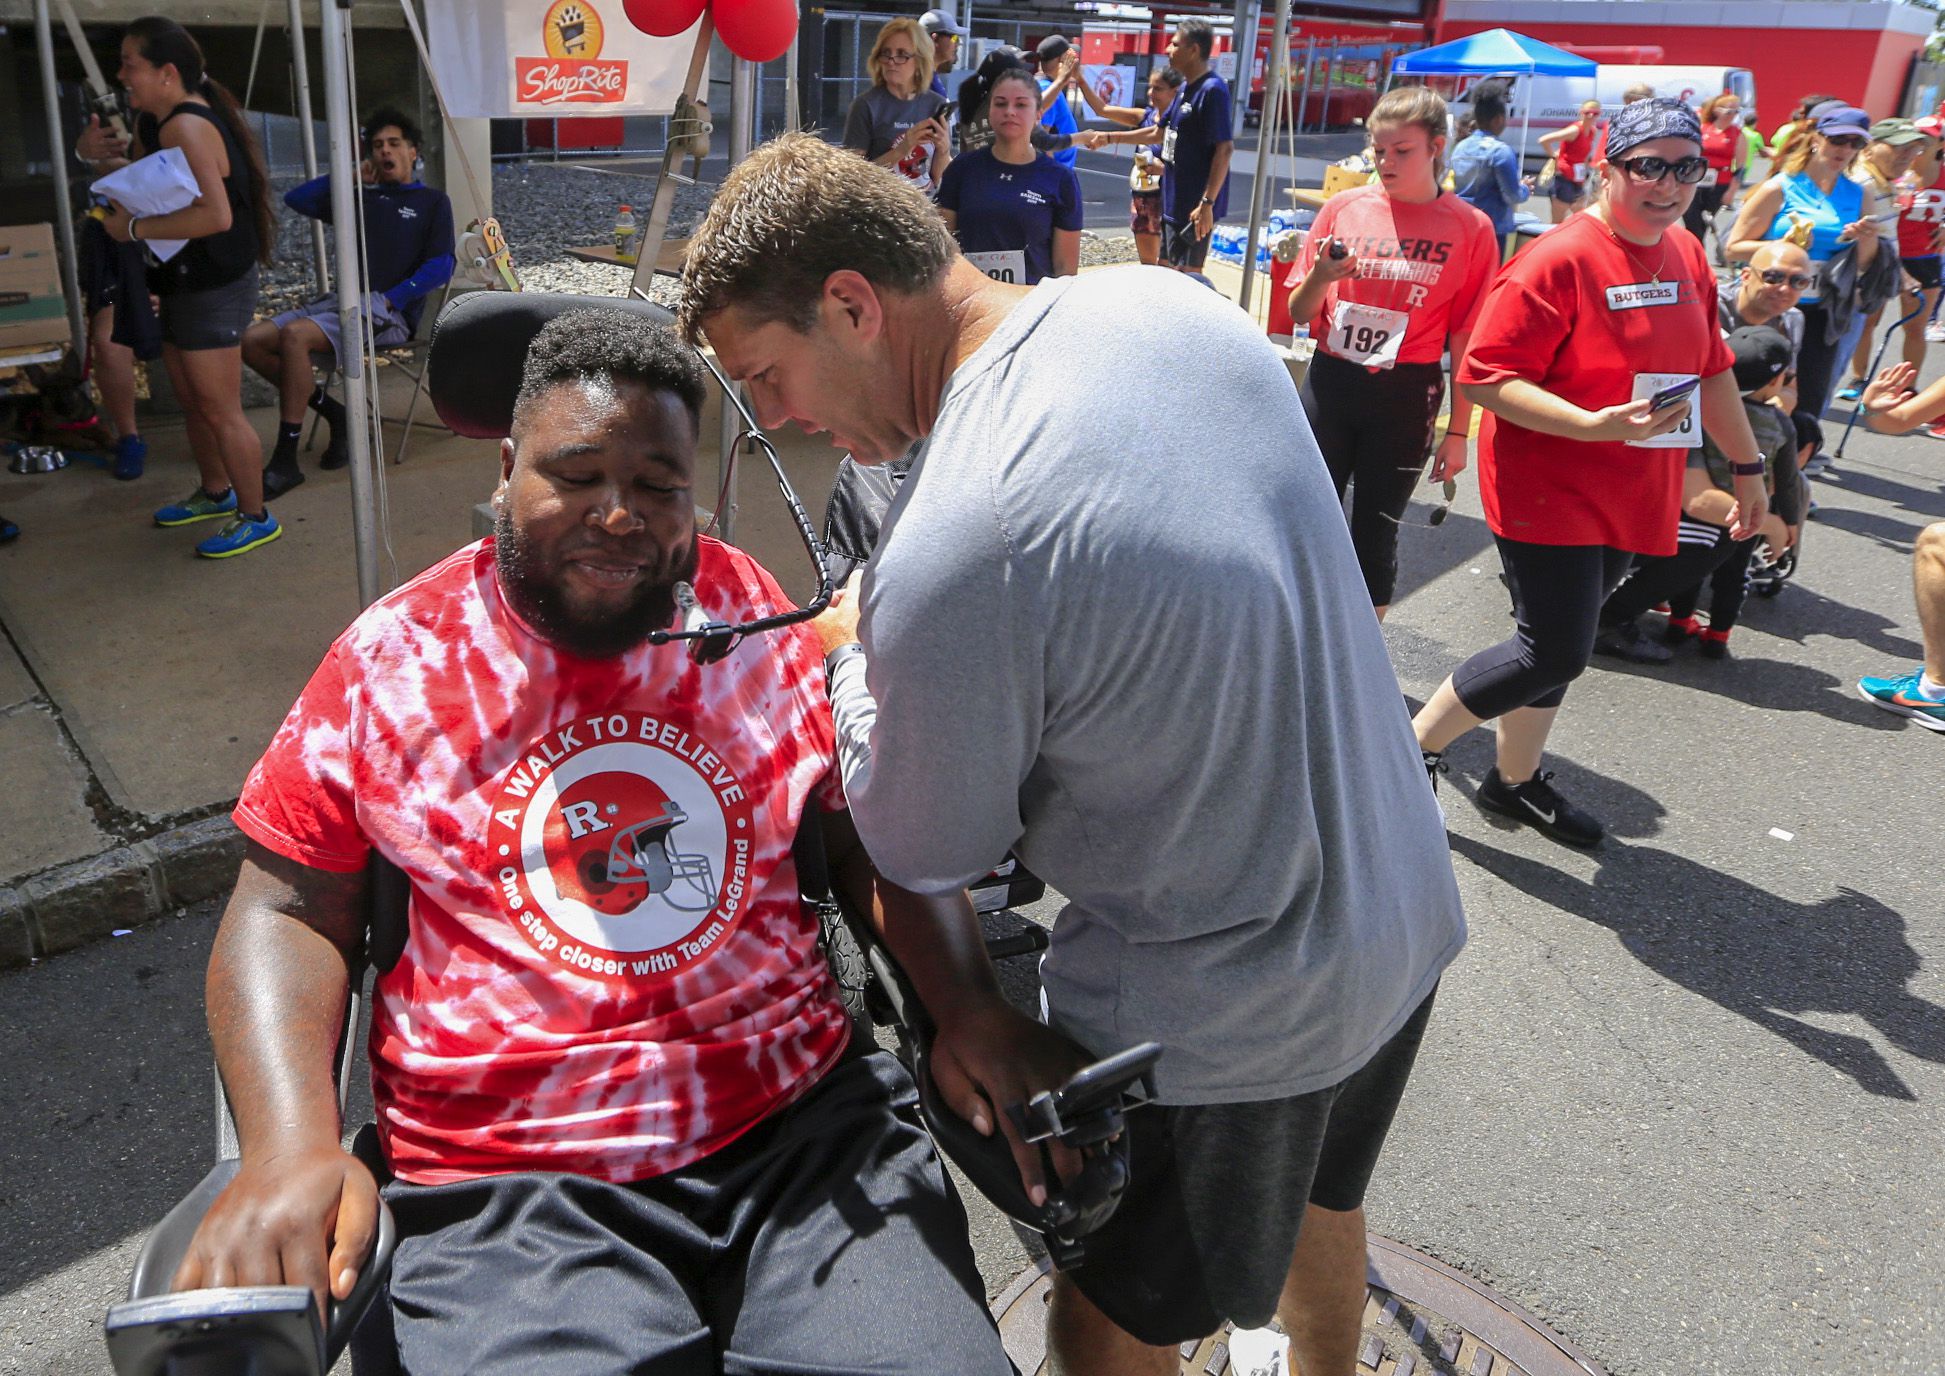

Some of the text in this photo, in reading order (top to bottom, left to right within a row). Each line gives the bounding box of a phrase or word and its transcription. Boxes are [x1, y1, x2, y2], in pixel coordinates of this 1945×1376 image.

[523, 64, 621, 101] ShopRite
[1406, 284, 1429, 307] R
[1614, 288, 1673, 303] RUTGERS
[1342, 324, 1390, 355] 192
[495, 715, 745, 830] A WALK TO BELIEVE
[560, 800, 609, 840] R
[499, 838, 749, 976] One step closer with Team LeGrand
